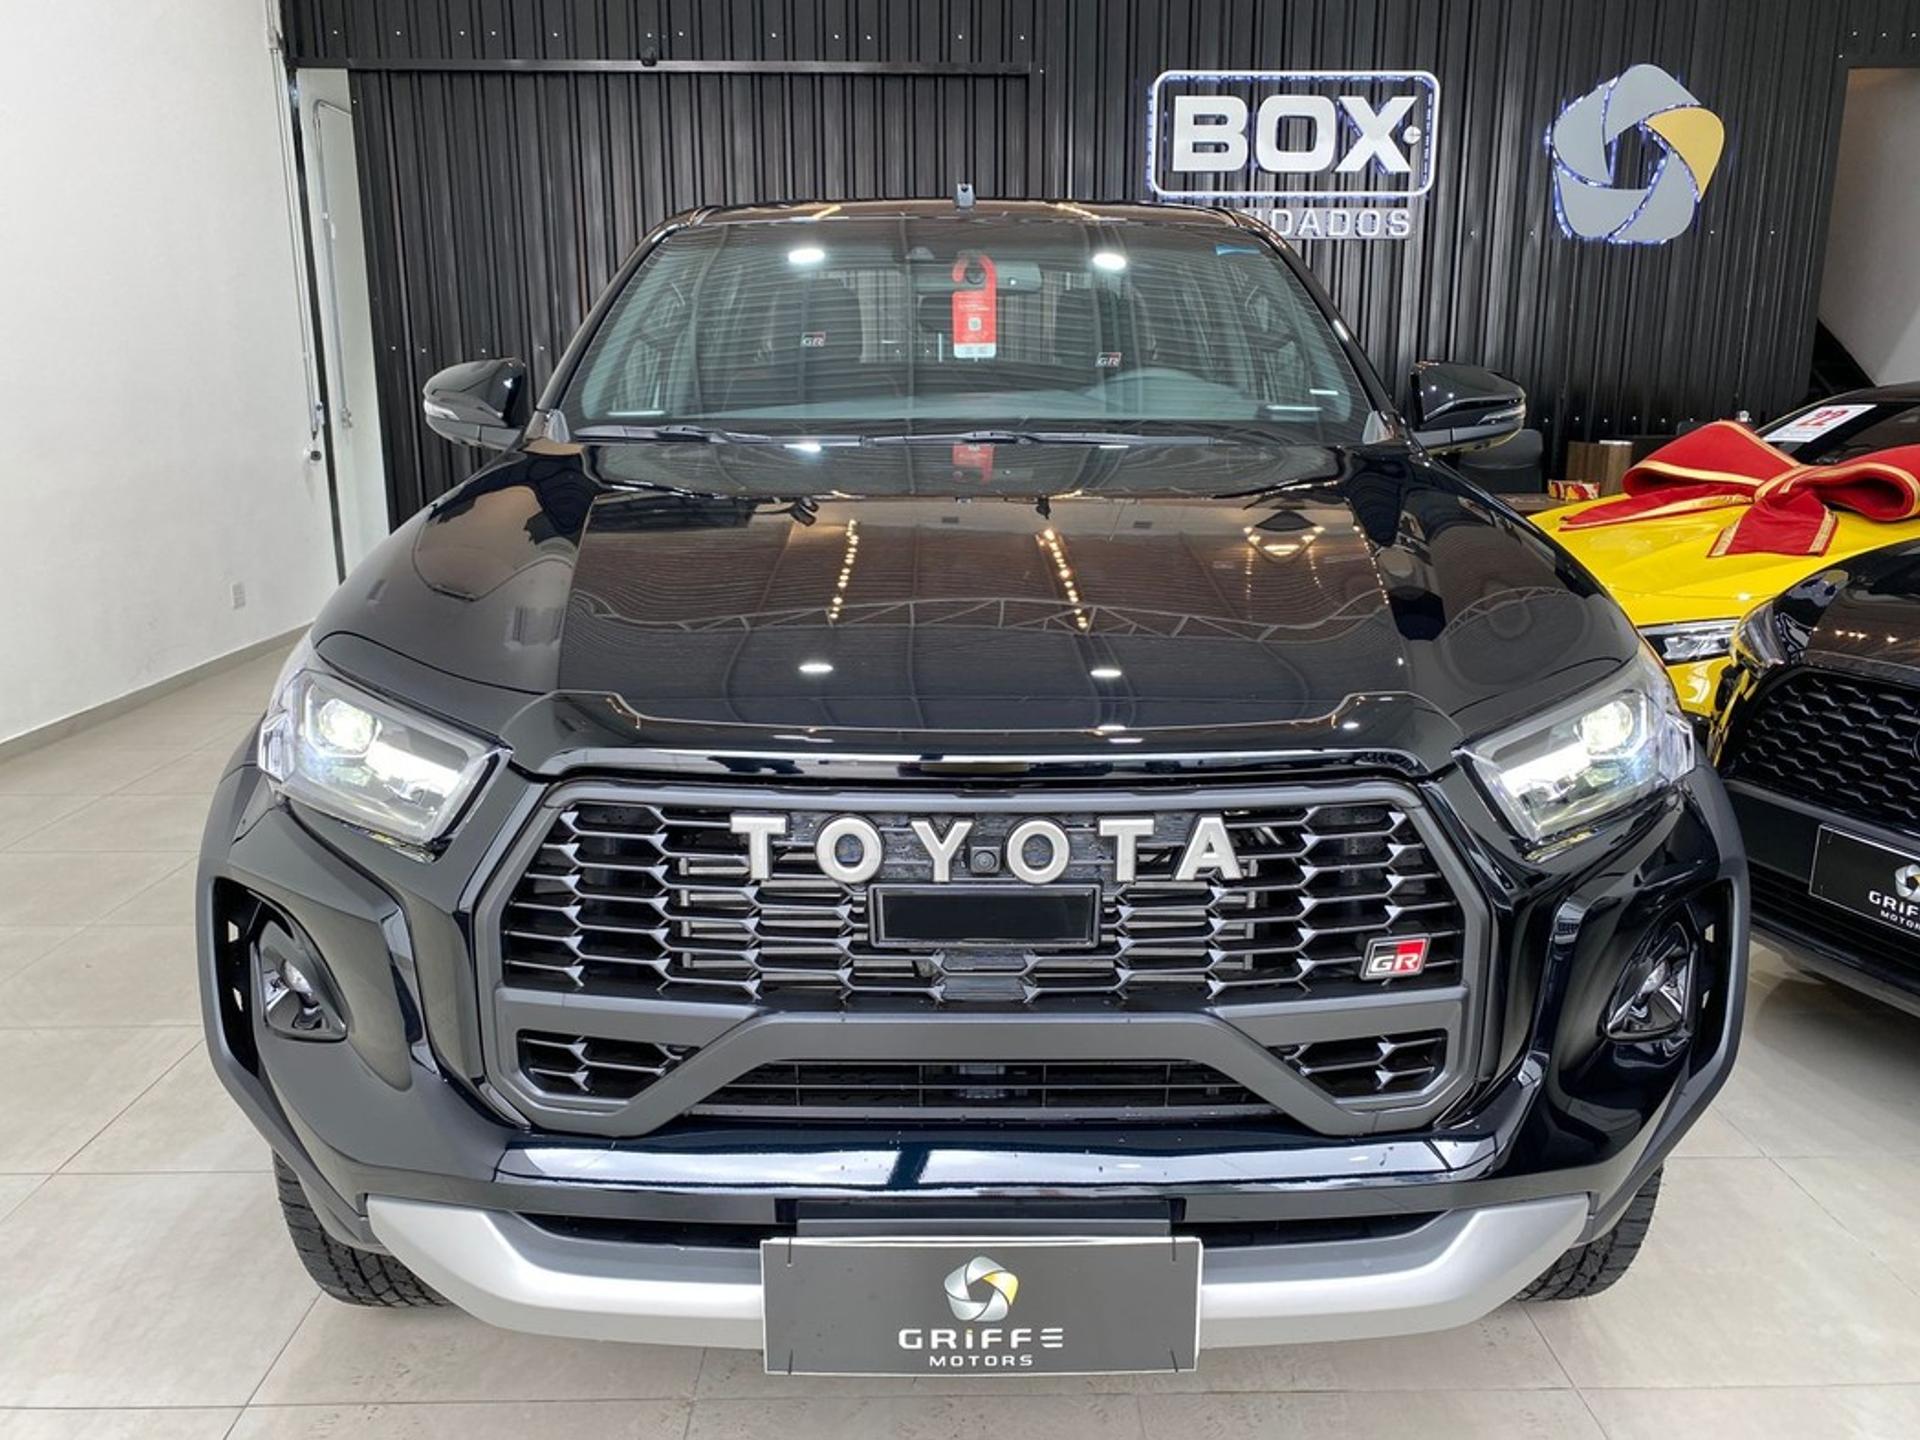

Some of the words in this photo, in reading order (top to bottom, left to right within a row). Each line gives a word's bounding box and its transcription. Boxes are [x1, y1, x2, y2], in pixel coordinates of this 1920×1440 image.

[1173, 95, 1417, 172] BOX
[1241, 209, 1409, 236] DADOS
[731, 815, 1243, 884] TOYOTA
[1371, 953, 1420, 972] GR
[929, 1354, 1033, 1367] MOTORS
